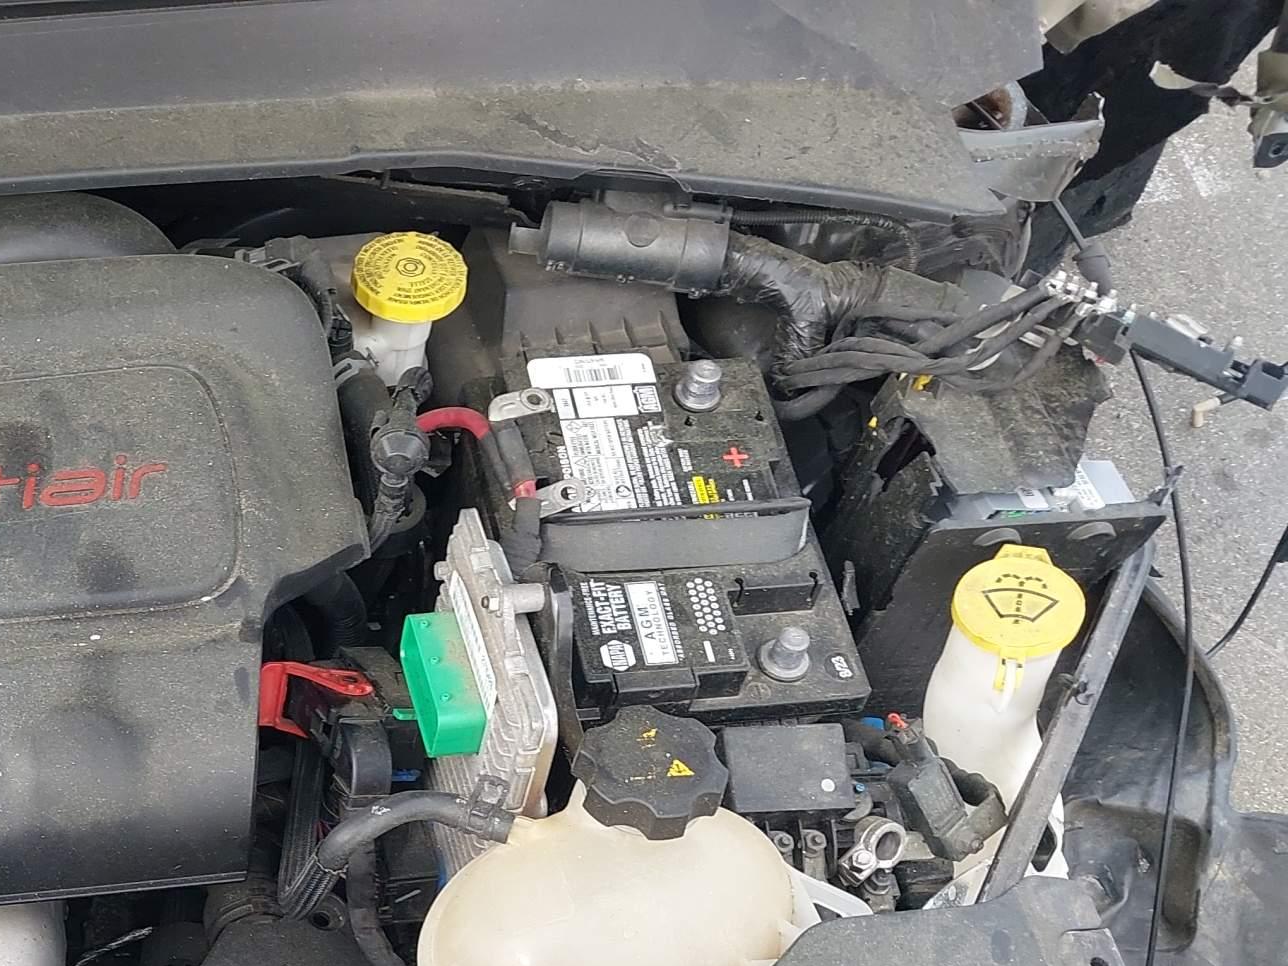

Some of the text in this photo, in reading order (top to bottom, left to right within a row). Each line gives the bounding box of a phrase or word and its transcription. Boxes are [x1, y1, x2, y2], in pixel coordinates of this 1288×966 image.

[637, 387, 659, 410] AGM
[556, 445, 574, 480] POISON
[589, 580, 618, 635] EXACT-FIT
[605, 582, 633, 631] BATTERY
[636, 606, 657, 641] AGM
[645, 589, 671, 657] TECHNOLOGY
[831, 655, 854, 679] 8/23
